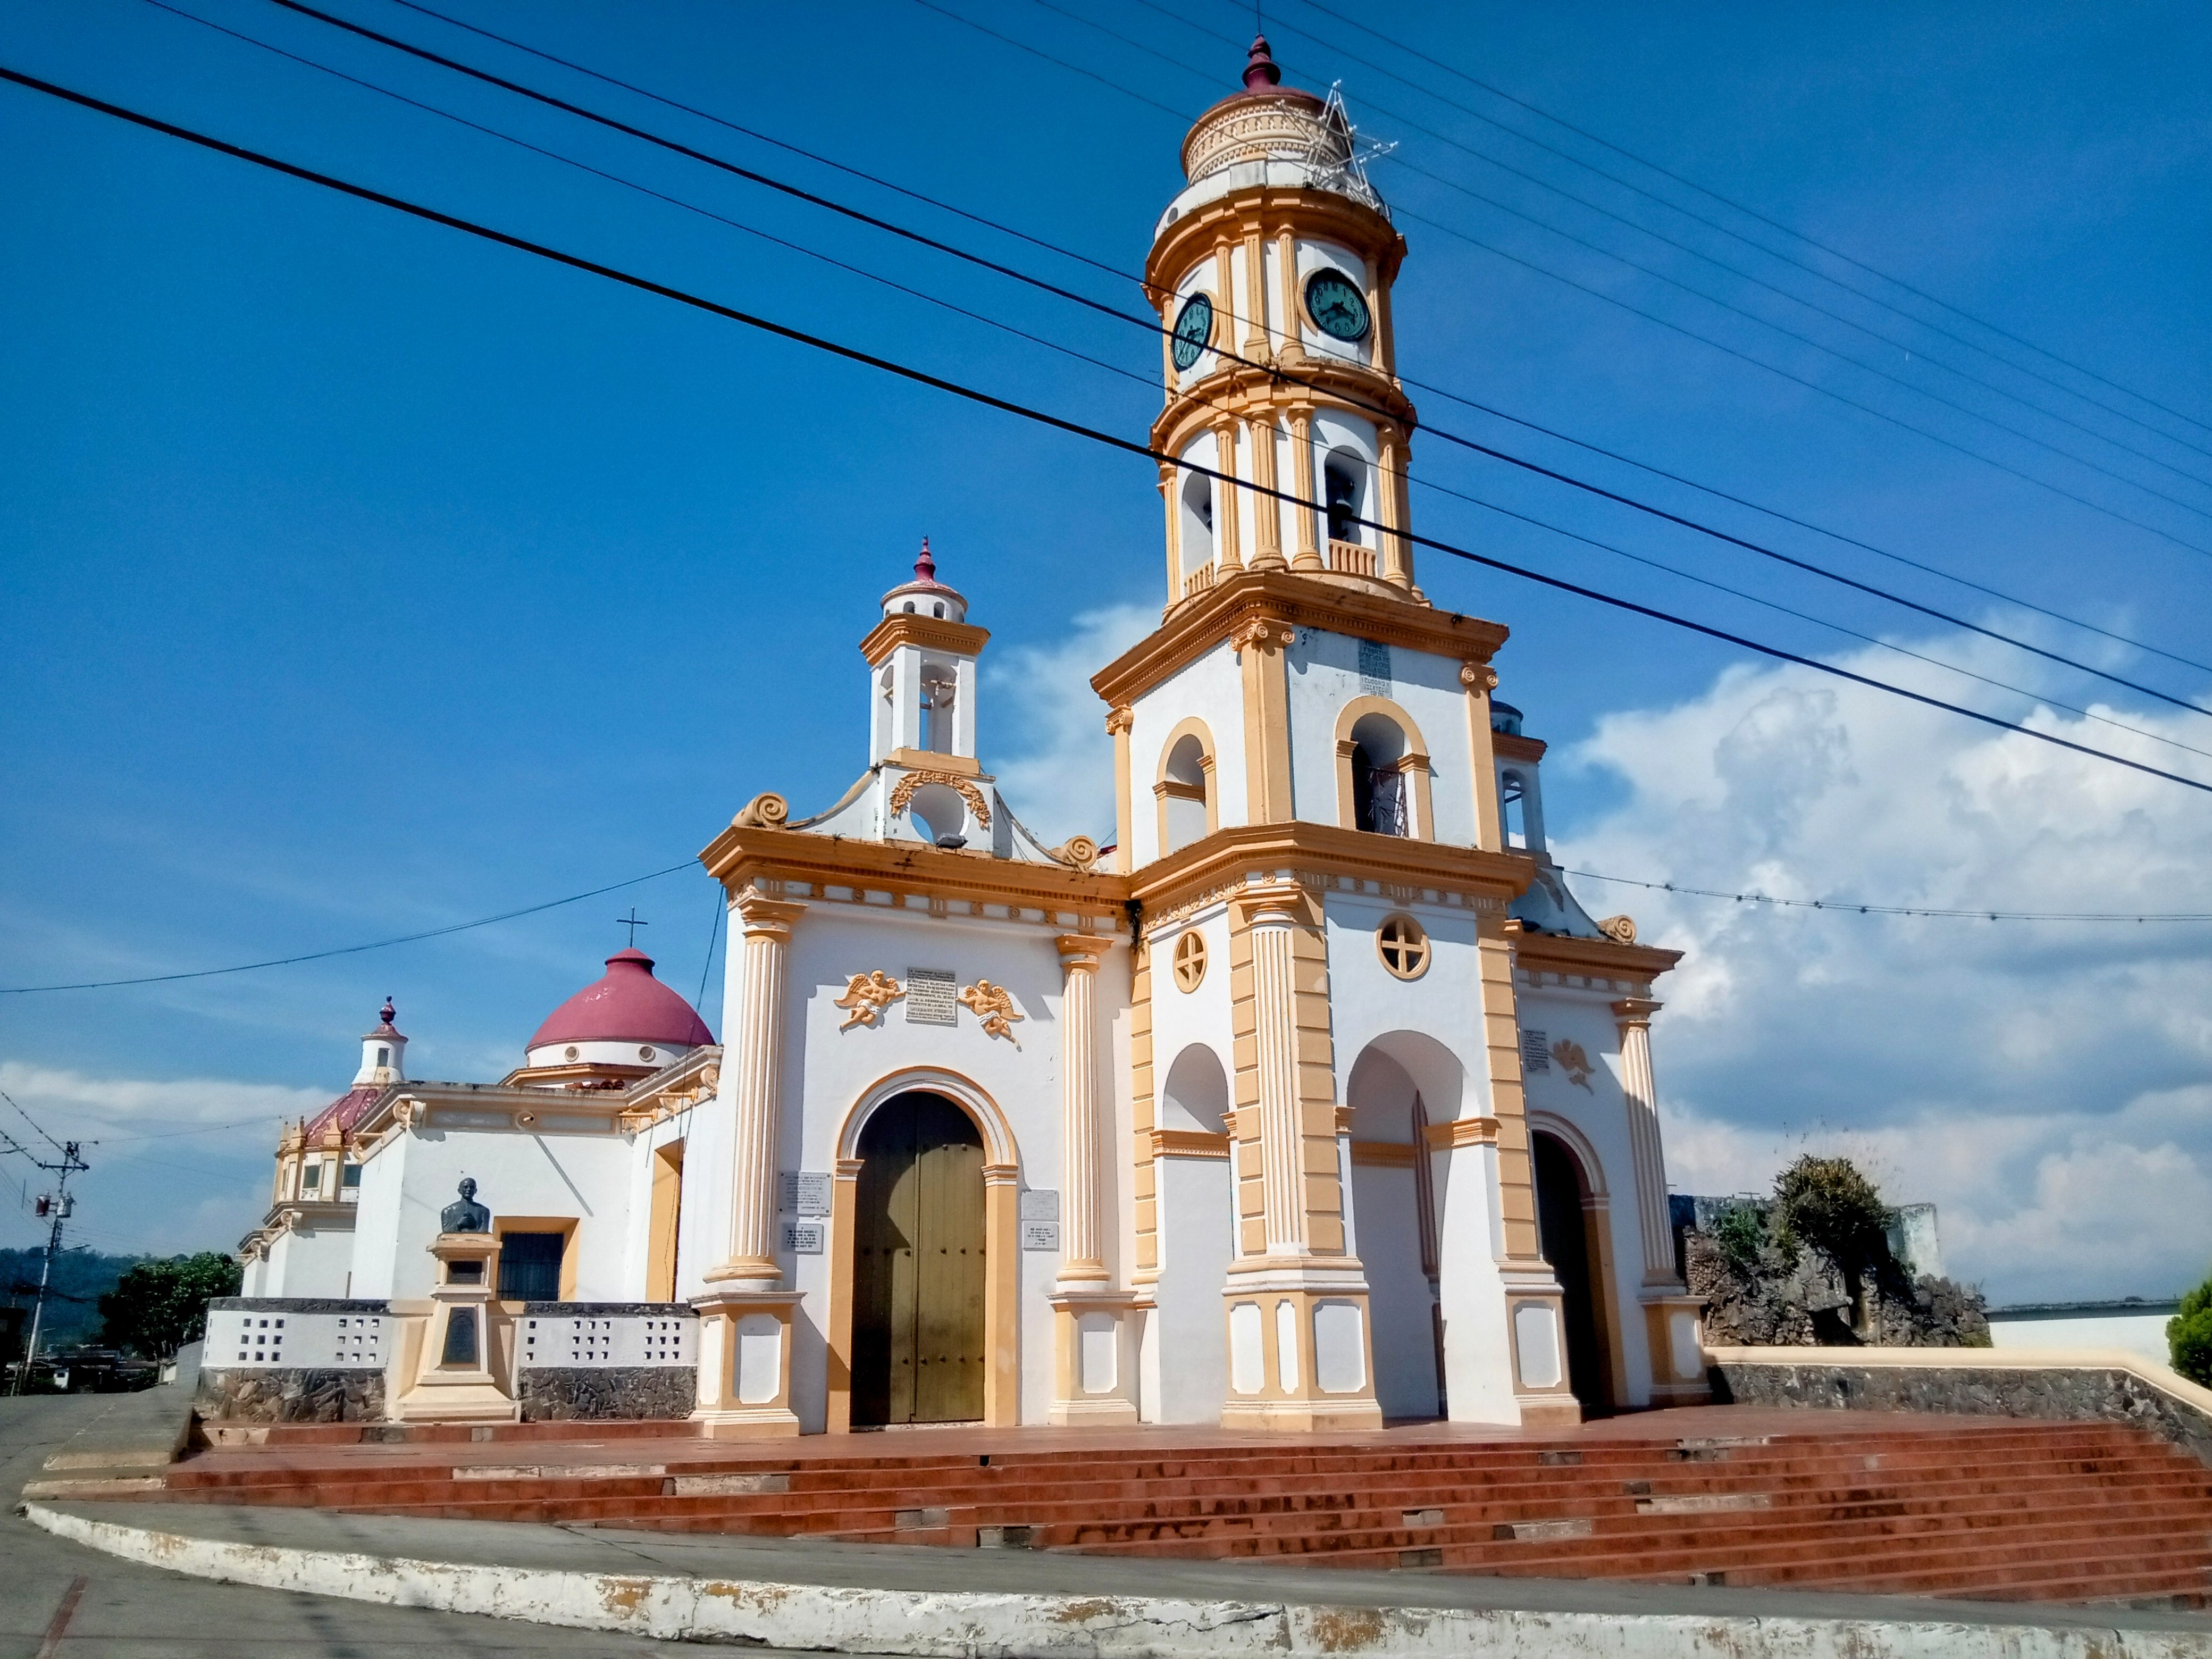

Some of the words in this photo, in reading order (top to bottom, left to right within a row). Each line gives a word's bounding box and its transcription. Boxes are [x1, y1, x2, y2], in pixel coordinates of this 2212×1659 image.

[1343, 288, 1346, 297] 1
[1315, 296, 1320, 305] 9
[1350, 298, 1354, 307] 2
[1335, 322, 1340, 332] 6
